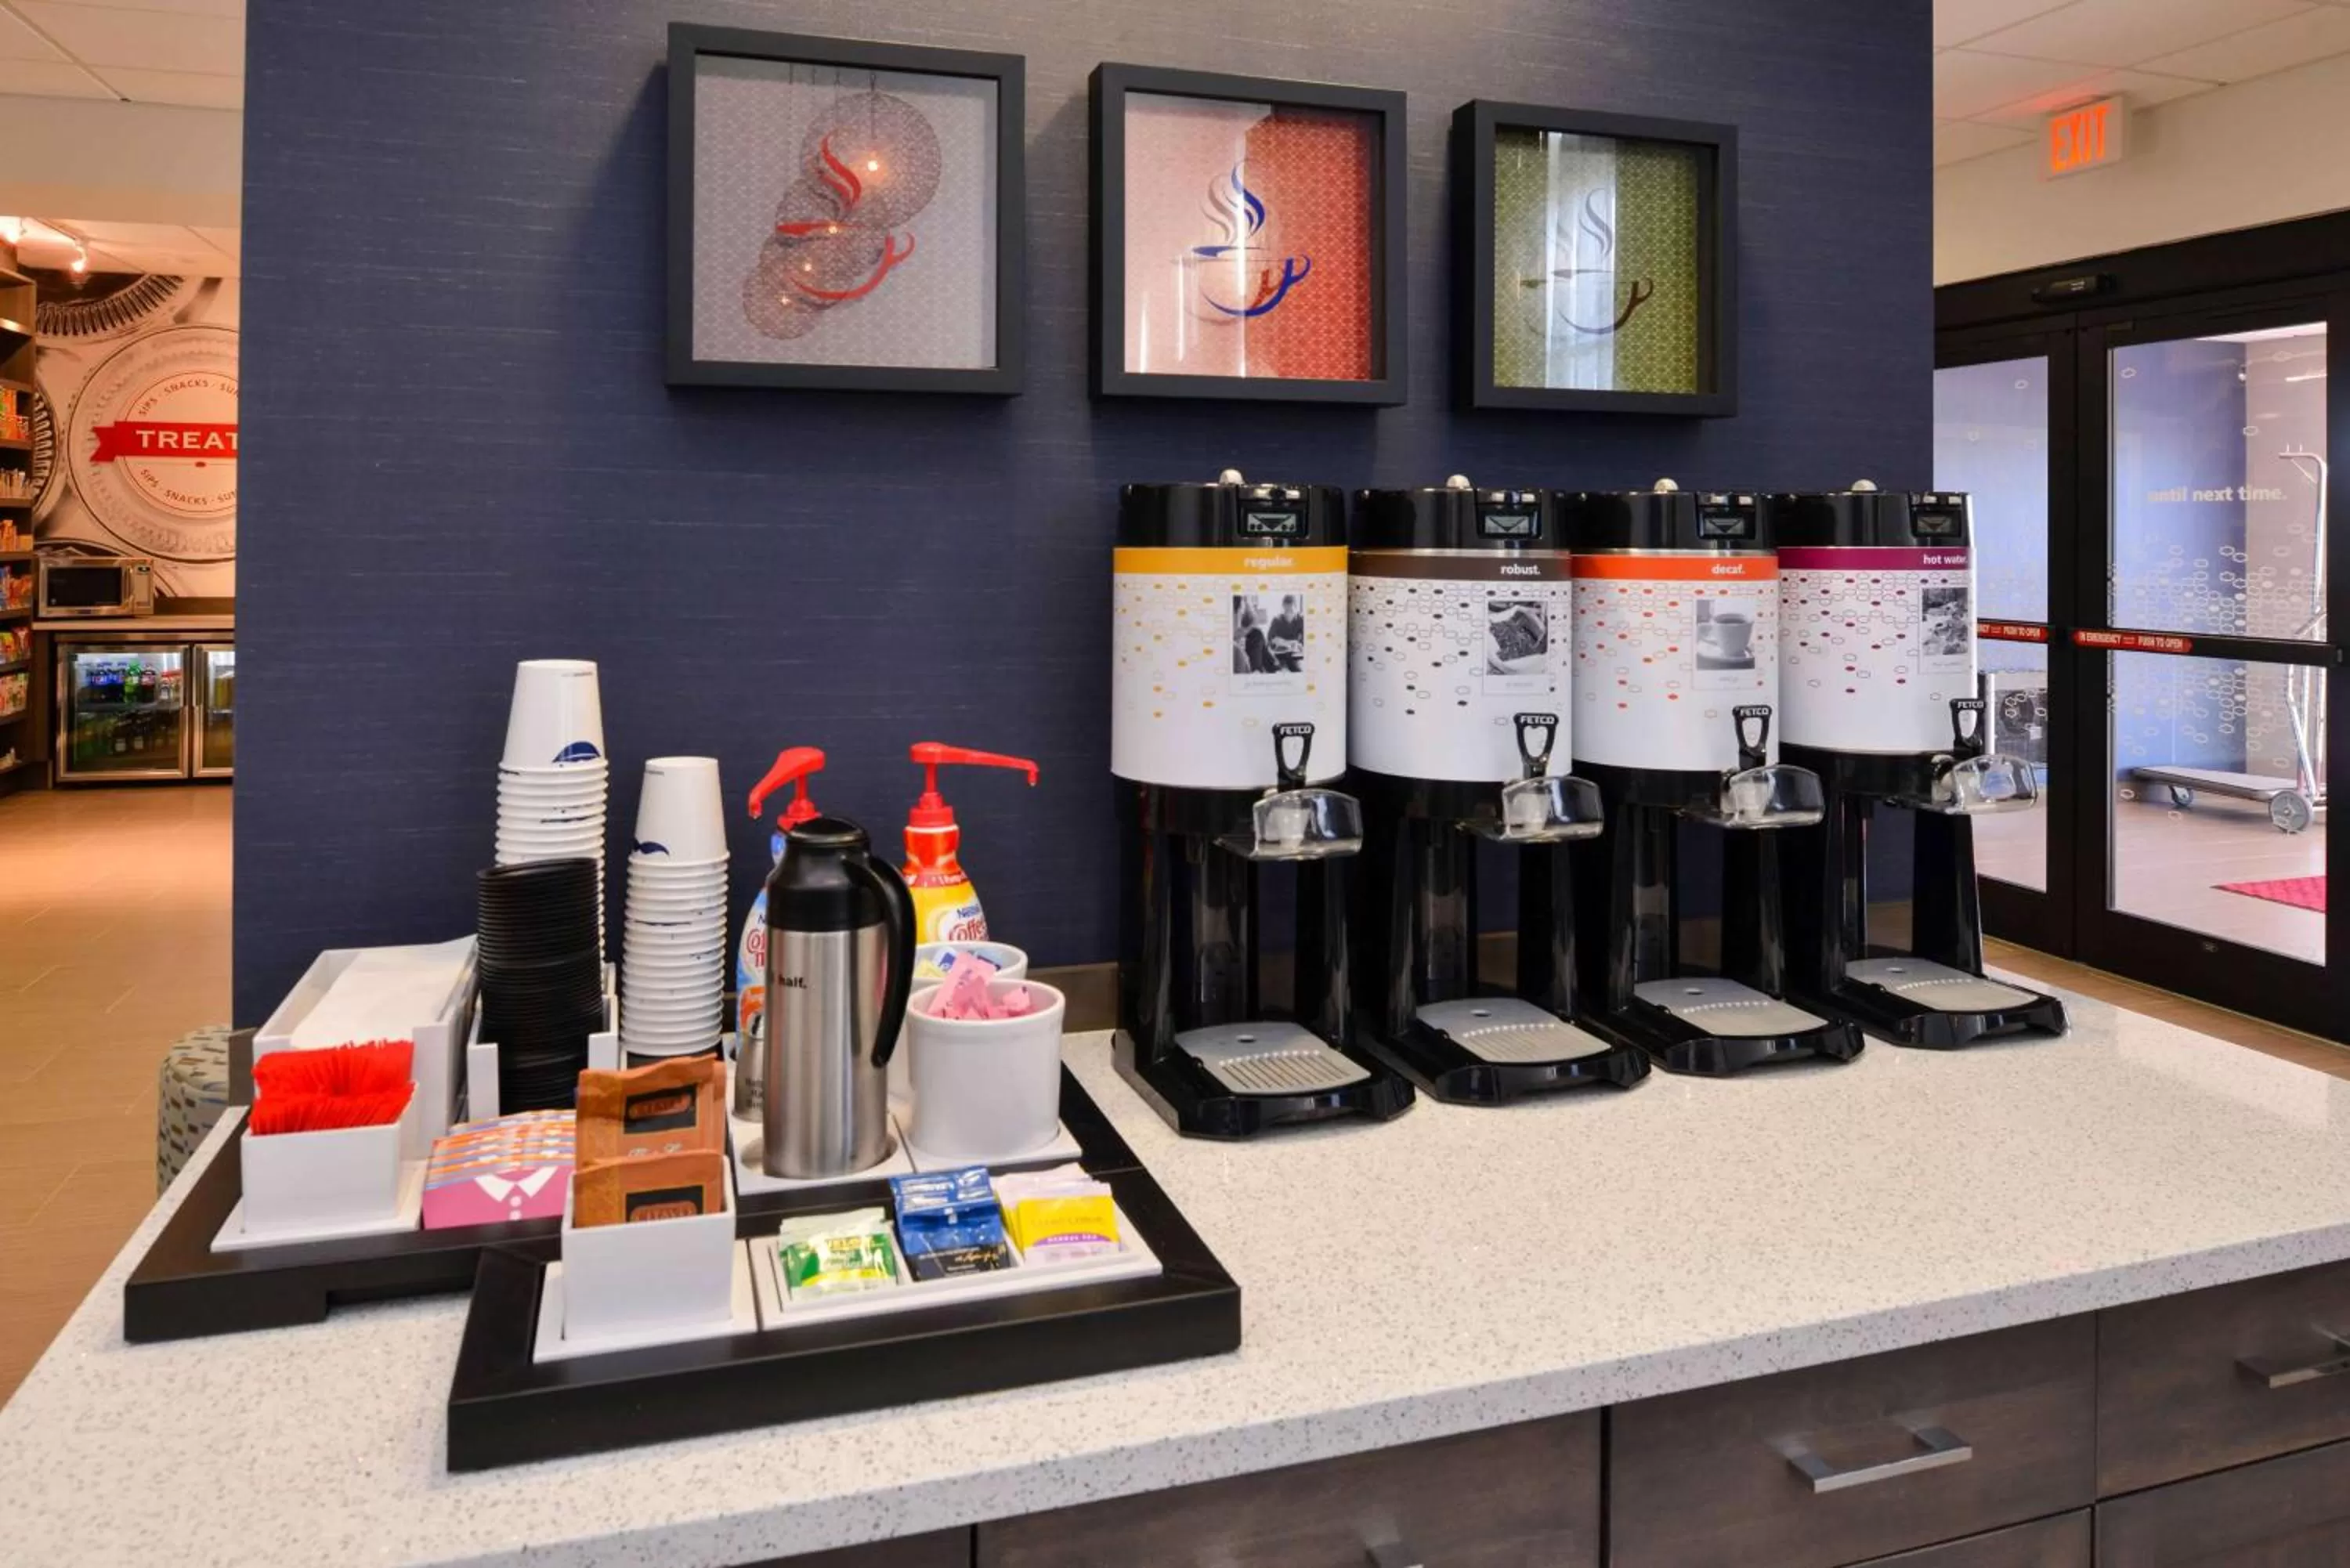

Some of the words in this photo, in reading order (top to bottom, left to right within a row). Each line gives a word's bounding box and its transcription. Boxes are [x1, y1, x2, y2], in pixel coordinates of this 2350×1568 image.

[2050, 104, 2110, 174] EXIT
[164, 378, 208, 394] SNACKS
[136, 429, 238, 450] TREAT
[164, 490, 208, 505] SNACKS
[2148, 486, 2188, 502] until
[2193, 486, 2234, 502] next
[2237, 484, 2289, 502] time.
[1923, 553, 1942, 565] hot
[1500, 563, 1541, 576] robust.
[1710, 562, 1747, 575] decaf.
[2165, 638, 2184, 650] OPEN
[1957, 700, 1984, 709] FETCO
[1740, 706, 1770, 717] FETCO
[1520, 715, 1556, 725] FETCO
[1280, 725, 1312, 735] FETCO
[778, 974, 808, 988] half.
